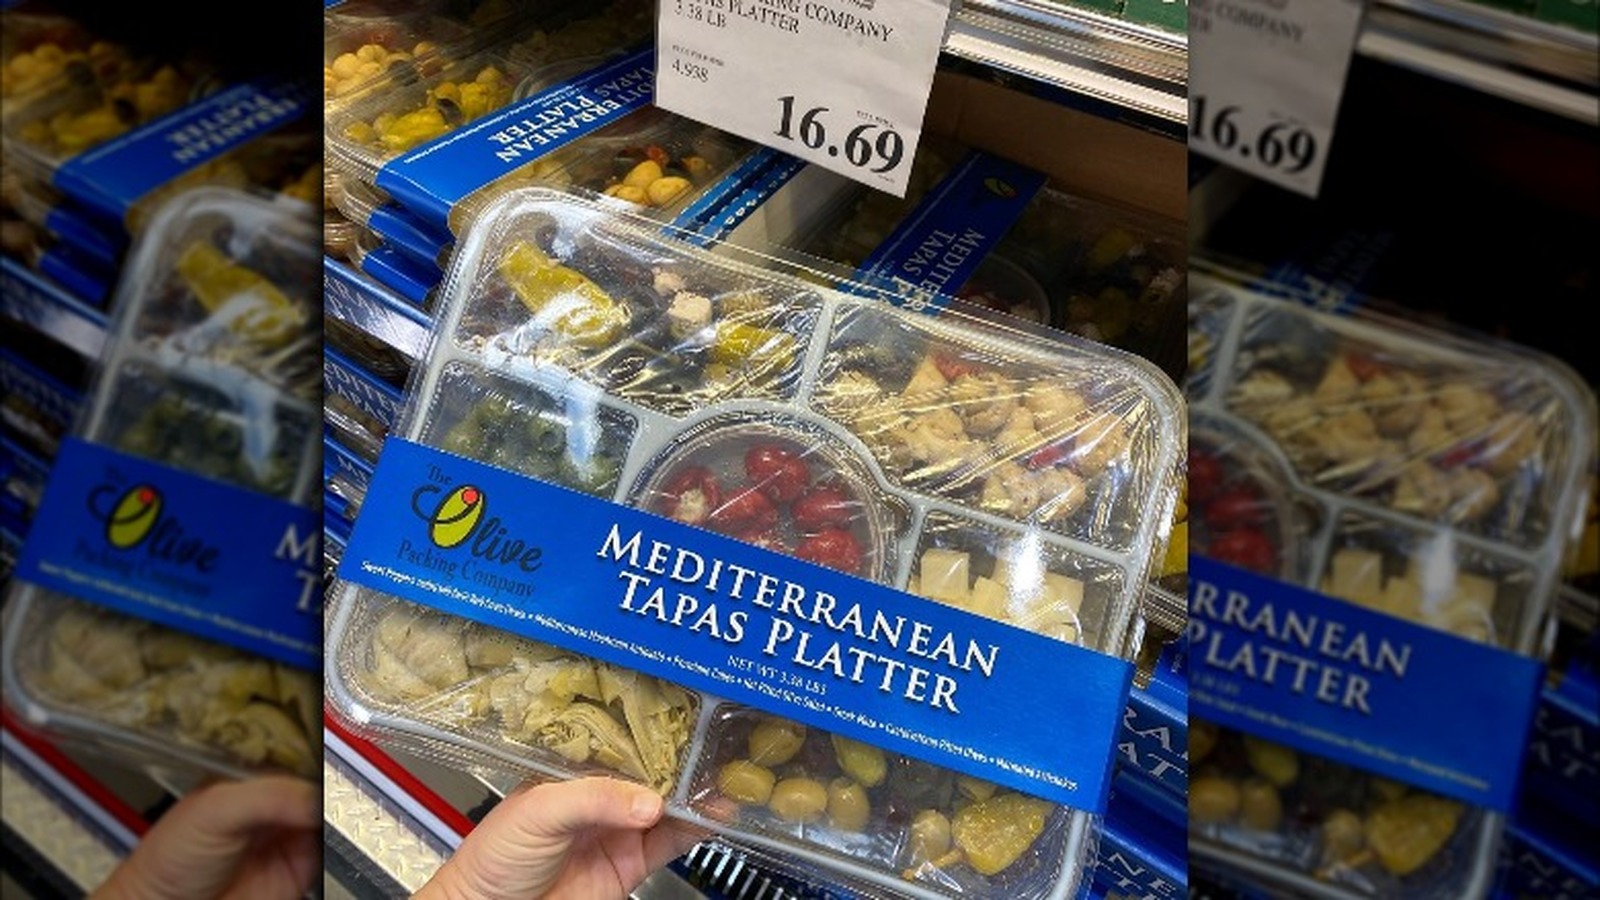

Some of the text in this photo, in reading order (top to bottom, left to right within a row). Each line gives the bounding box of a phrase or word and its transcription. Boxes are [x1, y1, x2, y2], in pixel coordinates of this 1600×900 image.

[728, 0, 799, 33] PLATTER
[805, 2, 893, 41] COMPANY
[488, 95, 594, 144] PLATTER
[773, 95, 904, 173] 16.69
[1188, 96, 1318, 174] 16.69
[411, 484, 543, 573] Olive
[398, 538, 457, 580] Packing
[462, 558, 535, 599] Company
[597, 523, 999, 678] MEDITERRANEAN
[618, 570, 749, 644] TAPAS
[762, 615, 960, 714] PLATTER
[728, 655, 753, 673] NET
[756, 663, 779, 679] WT
